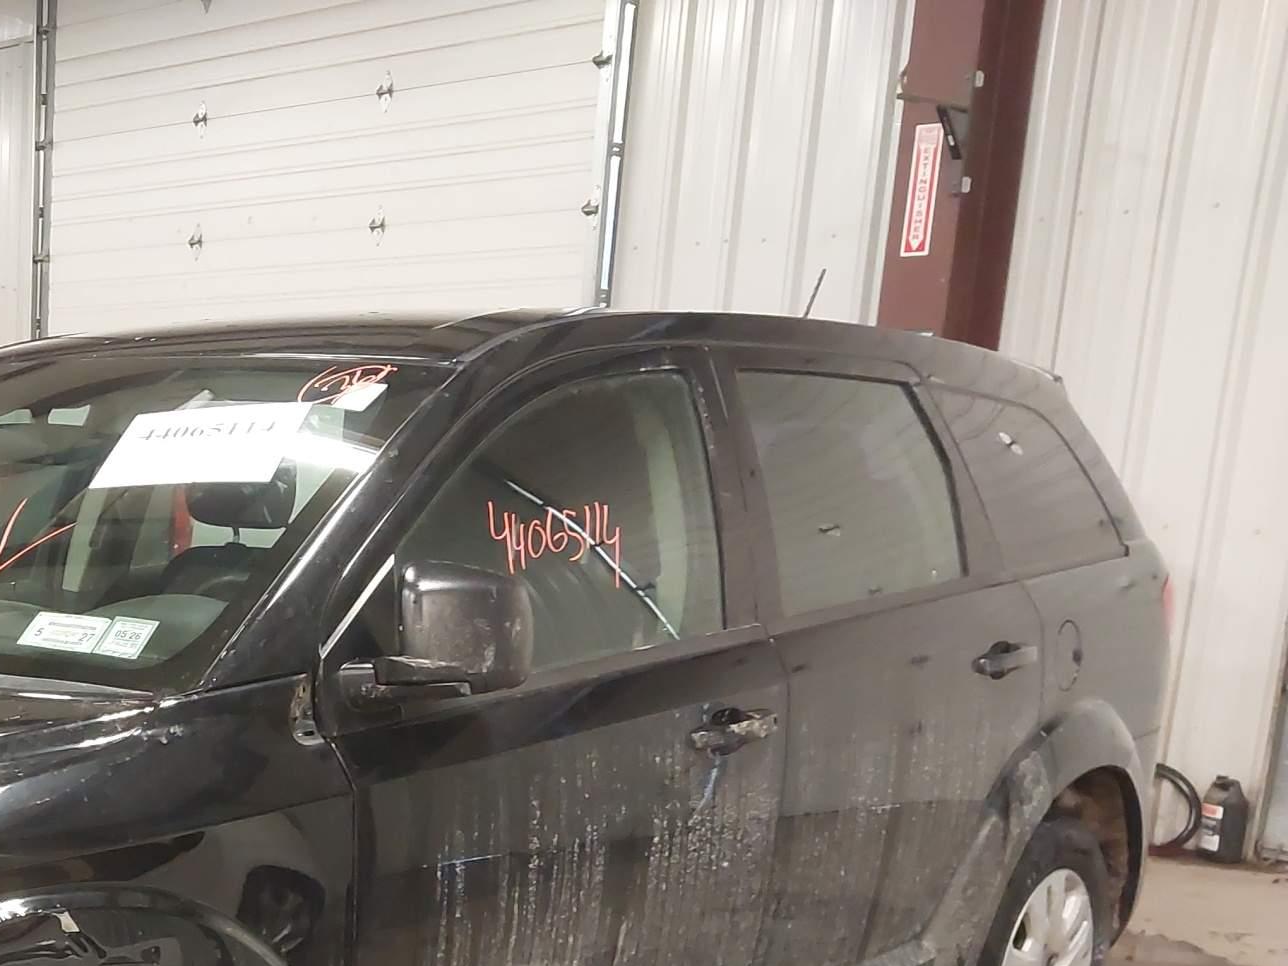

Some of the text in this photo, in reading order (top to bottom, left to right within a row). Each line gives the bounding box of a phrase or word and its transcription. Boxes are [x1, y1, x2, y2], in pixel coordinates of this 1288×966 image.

[912, 148, 931, 240] EXTINGUISHER
[488, 501, 620, 588] 44065114
[34, 627, 45, 637] 5
[79, 632, 96, 643] 27
[114, 629, 143, 641] 05 26
